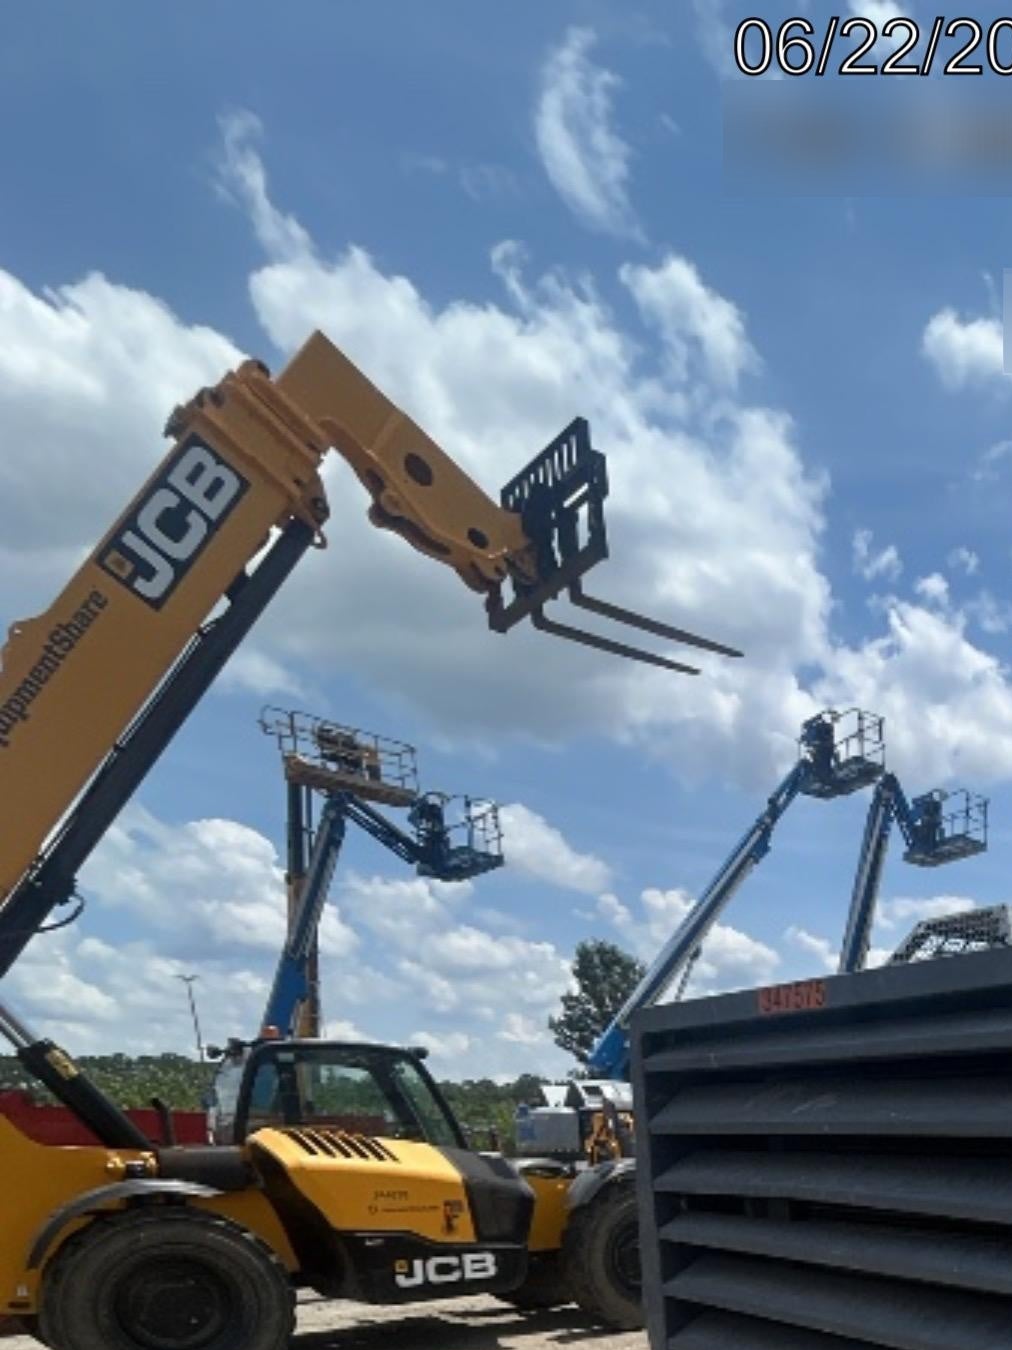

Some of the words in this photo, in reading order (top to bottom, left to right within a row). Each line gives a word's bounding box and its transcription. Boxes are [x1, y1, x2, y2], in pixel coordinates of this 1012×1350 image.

[120, 445, 241, 599] JCB
[0, 588, 108, 747] uipmentShare
[395, 1252, 497, 1288] JCB
